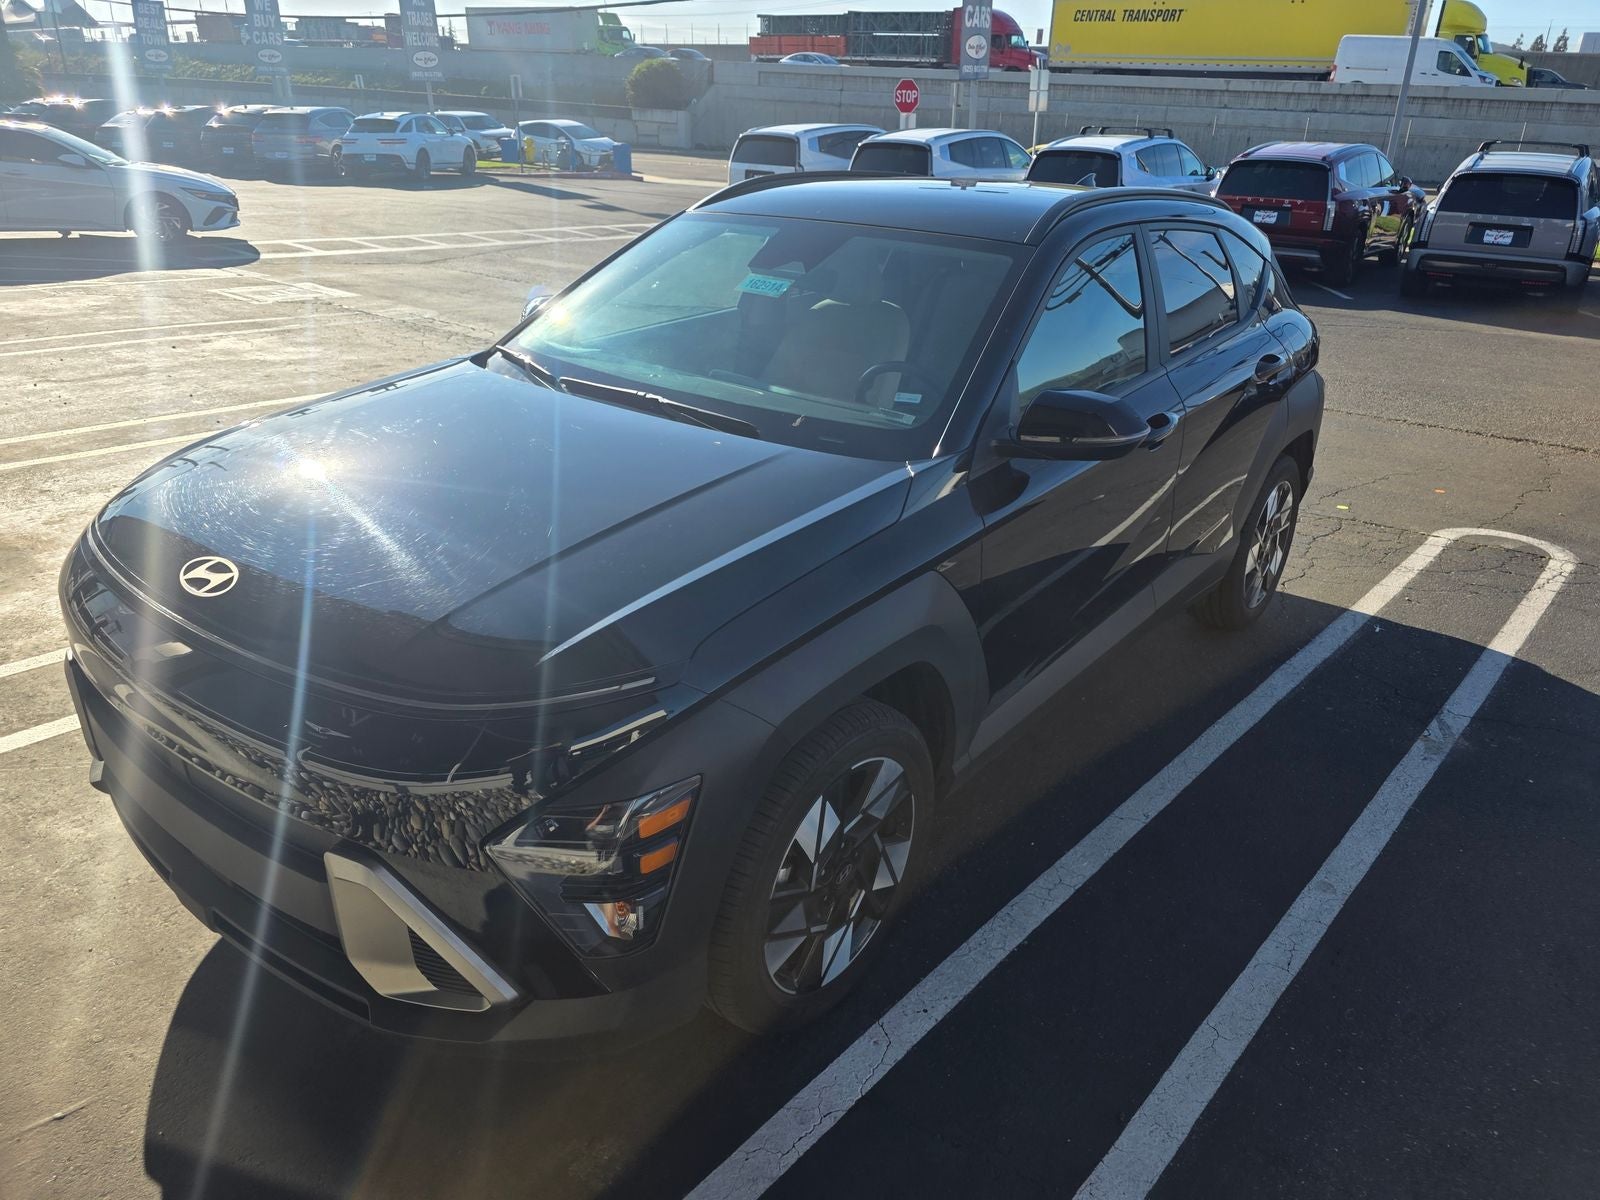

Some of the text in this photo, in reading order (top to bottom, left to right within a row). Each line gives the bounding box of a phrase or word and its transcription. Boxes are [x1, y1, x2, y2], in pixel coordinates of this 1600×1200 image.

[137, 3, 161, 15] BEST
[253, 0, 272, 12] WE
[253, 14, 275, 28] BUY
[406, 11, 434, 27] TRADES
[965, 4, 990, 28] CARS
[1073, 9, 1184, 22] CENTRAL TRANSPORT
[137, 18, 166, 30] DEALS
[141, 33, 168, 47] TOWN
[252, 31, 282, 45] CARS
[405, 32, 439, 47] WELCOME
[895, 90, 918, 103] STOP
[745, 278, 783, 293] 16291A
